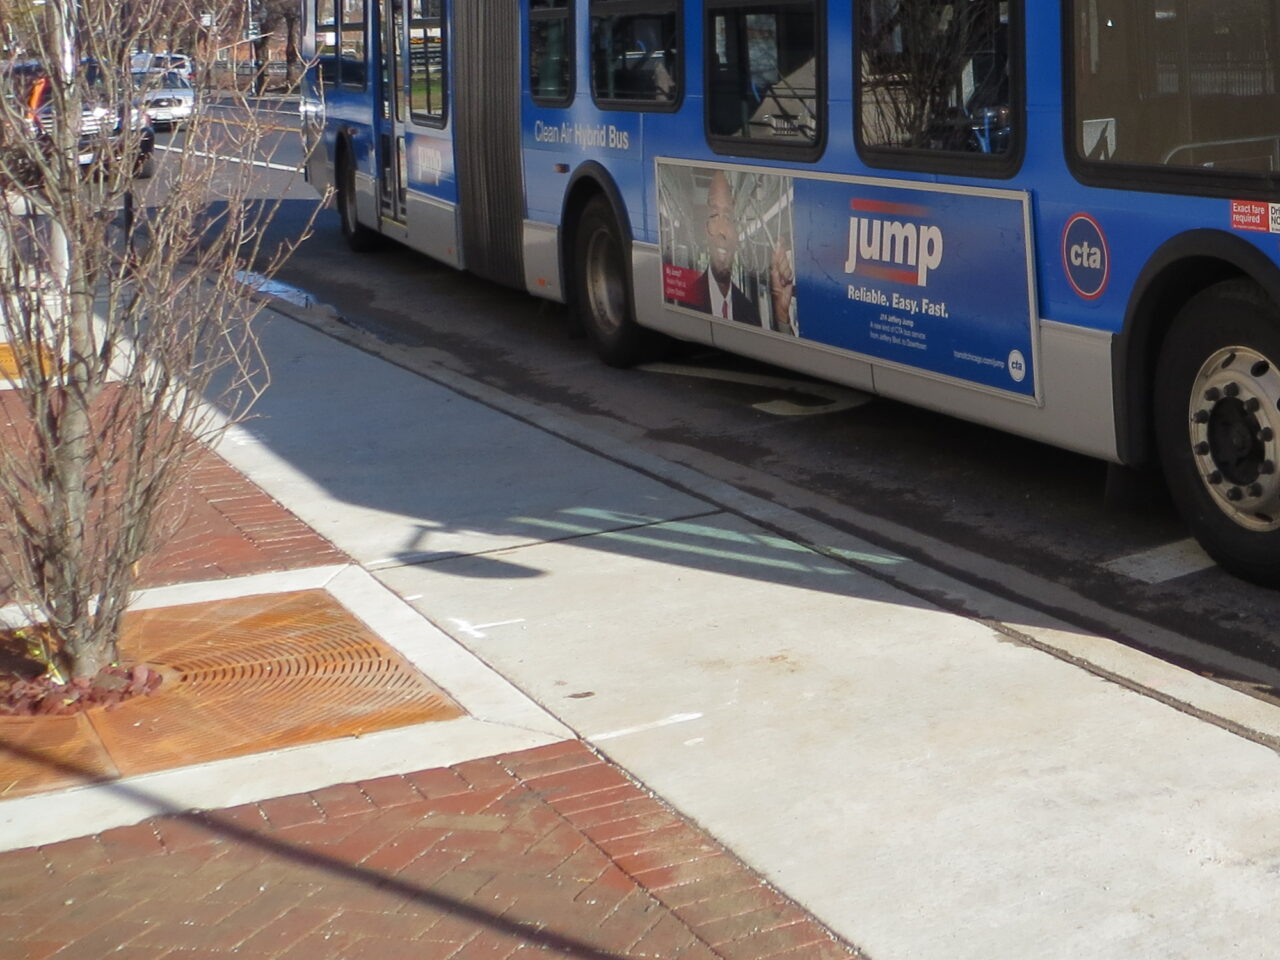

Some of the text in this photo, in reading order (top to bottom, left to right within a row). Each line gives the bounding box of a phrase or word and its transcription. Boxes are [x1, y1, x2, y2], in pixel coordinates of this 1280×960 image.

[534, 120, 629, 151] Clean Air Hybrid Bus
[1232, 203, 1265, 215] Exact fare
[1232, 214, 1260, 225] required
[845, 216, 943, 286] jump
[1070, 241, 1101, 269] cta
[847, 285, 949, 318] Reliable. Easy. Fast.
[1011, 360, 1023, 372] cta
